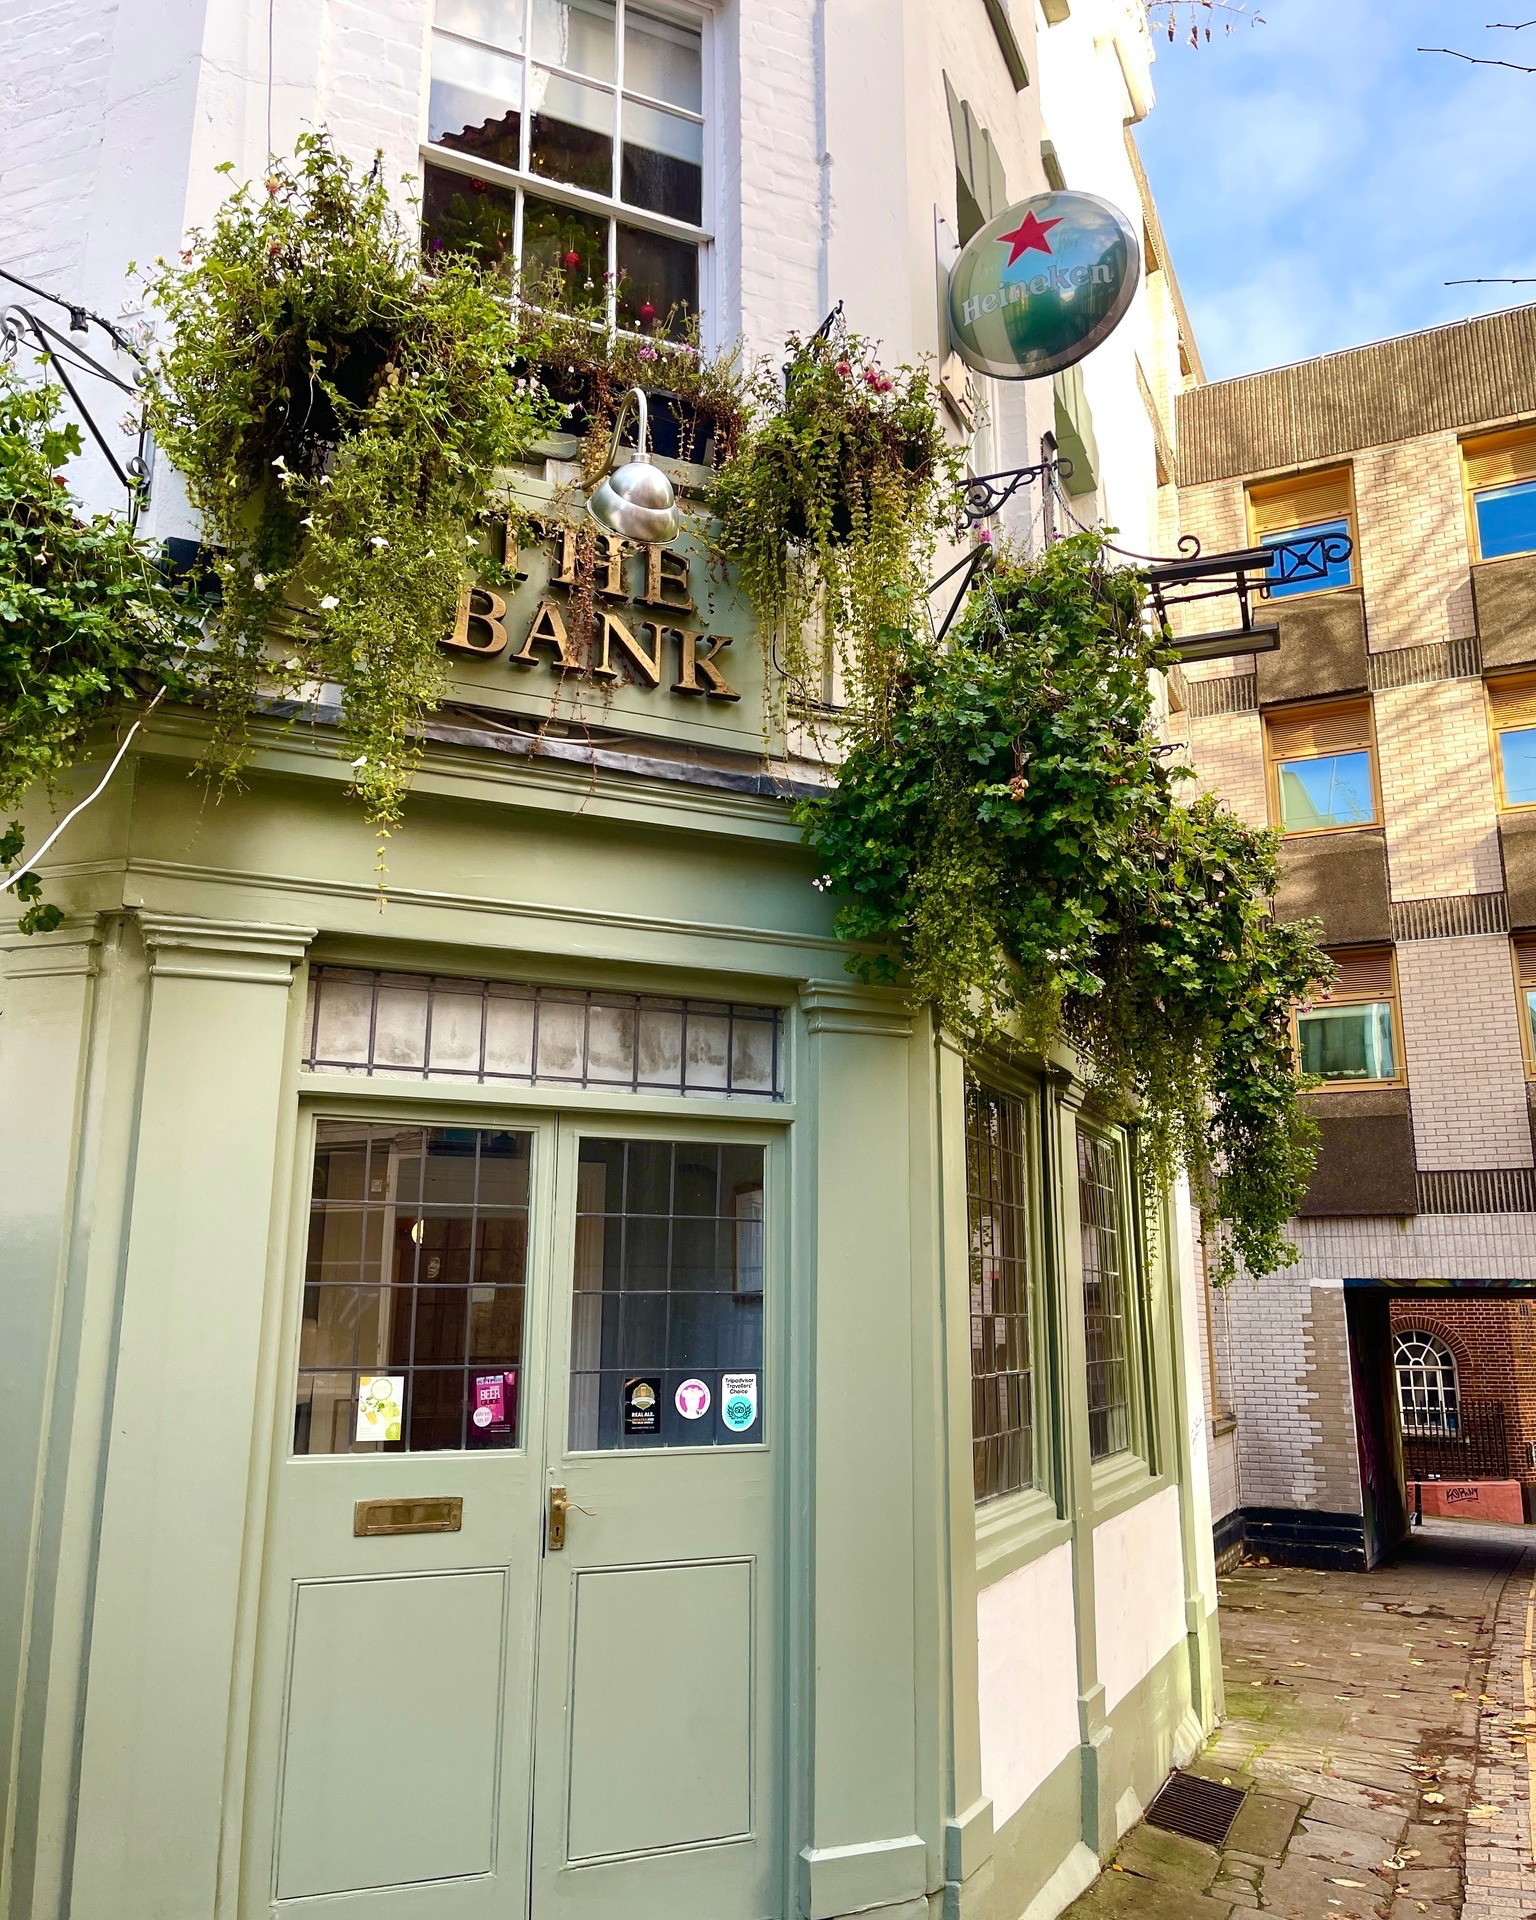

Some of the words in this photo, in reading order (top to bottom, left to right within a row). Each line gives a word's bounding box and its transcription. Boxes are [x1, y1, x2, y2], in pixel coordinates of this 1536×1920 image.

[962, 264, 1114, 327] Heineken
[476, 511, 694, 615] THE
[436, 586, 742, 702] BANK
[480, 1389, 500, 1400] BEER
